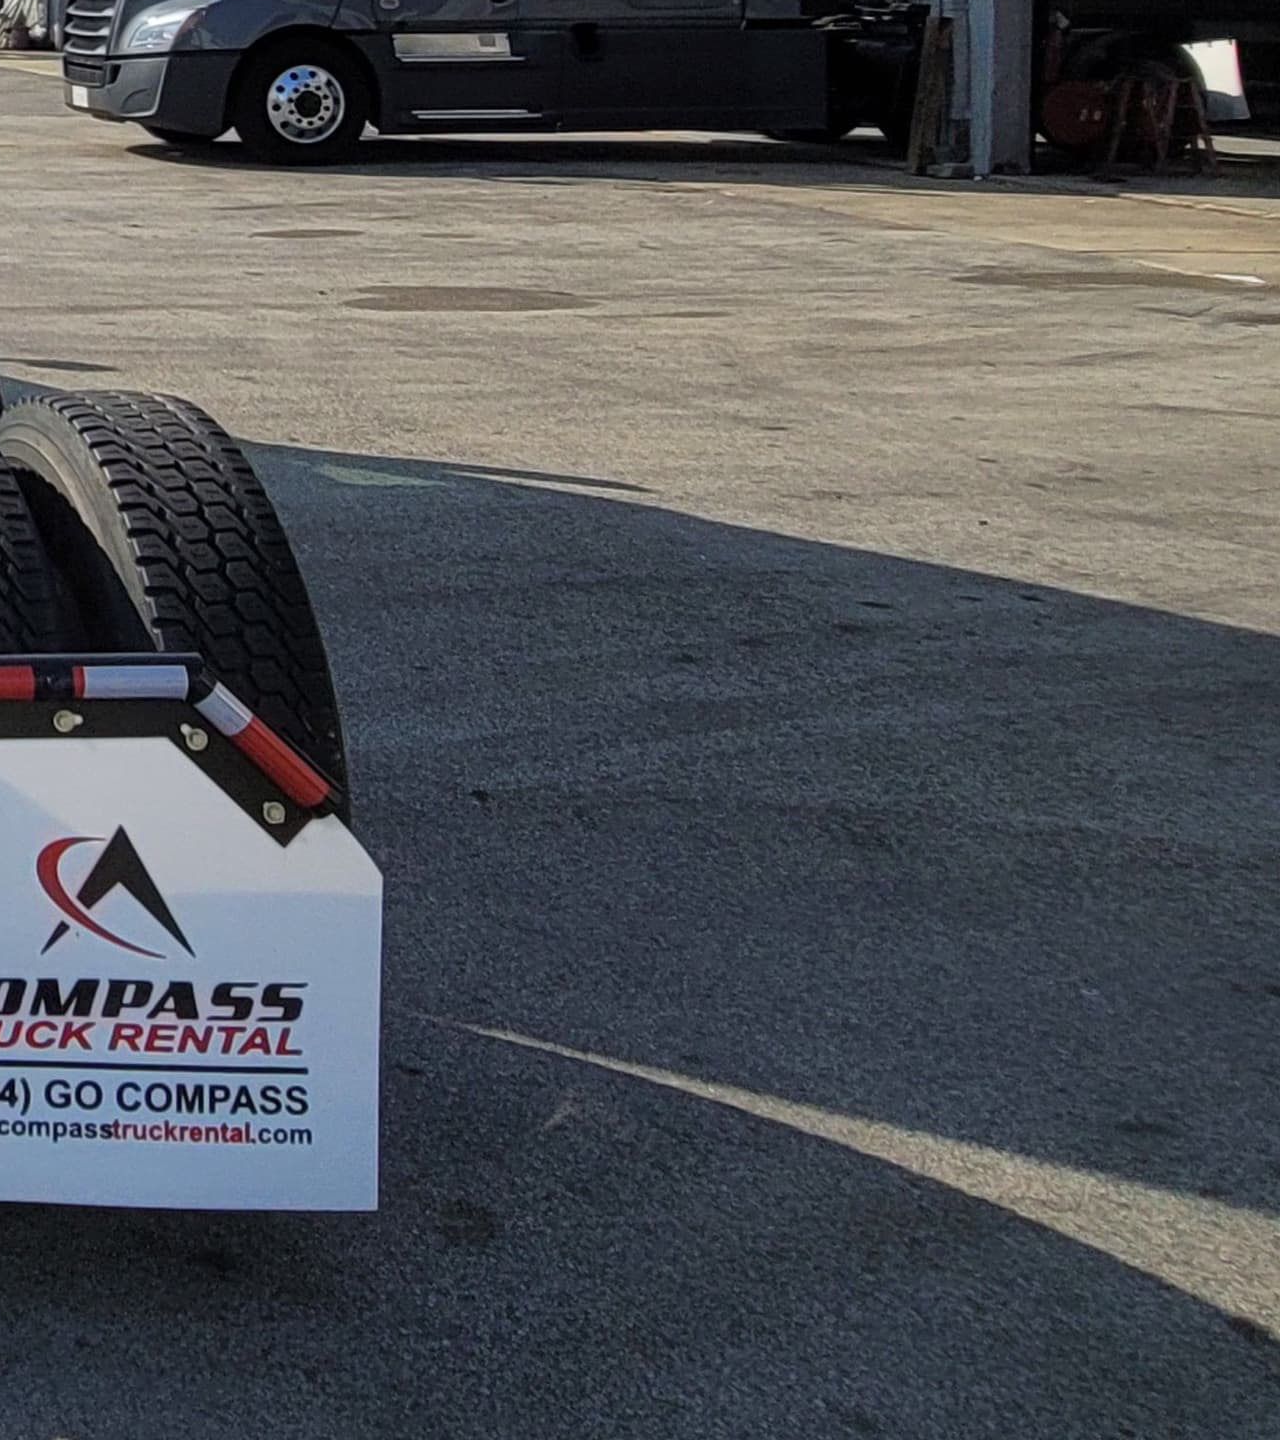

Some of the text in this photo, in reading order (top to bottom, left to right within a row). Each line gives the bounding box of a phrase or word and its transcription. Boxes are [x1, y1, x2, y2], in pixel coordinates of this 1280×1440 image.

[107, 1021, 303, 1056] RENTAL
[43, 1078, 104, 1110] GO
[115, 1081, 310, 1116] COMPASS
